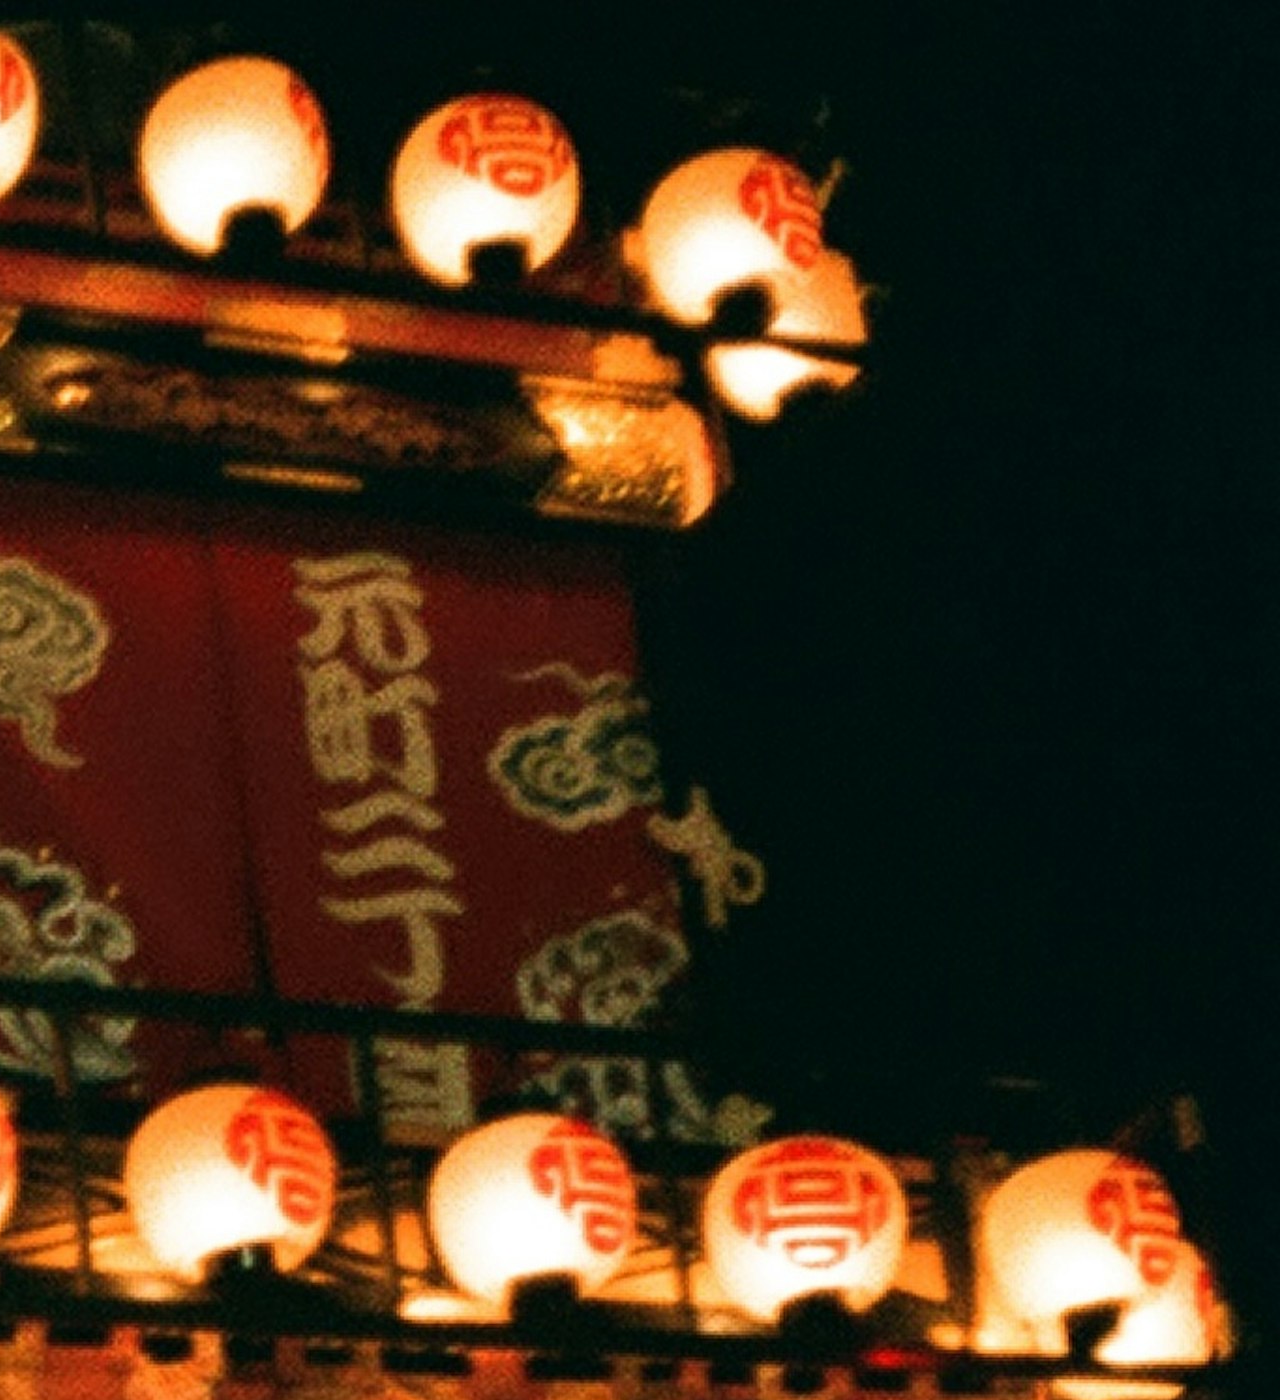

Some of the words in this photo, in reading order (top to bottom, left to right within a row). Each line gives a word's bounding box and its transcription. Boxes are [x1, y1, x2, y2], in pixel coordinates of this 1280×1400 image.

[292, 551, 474, 1140] 元町二丁目
